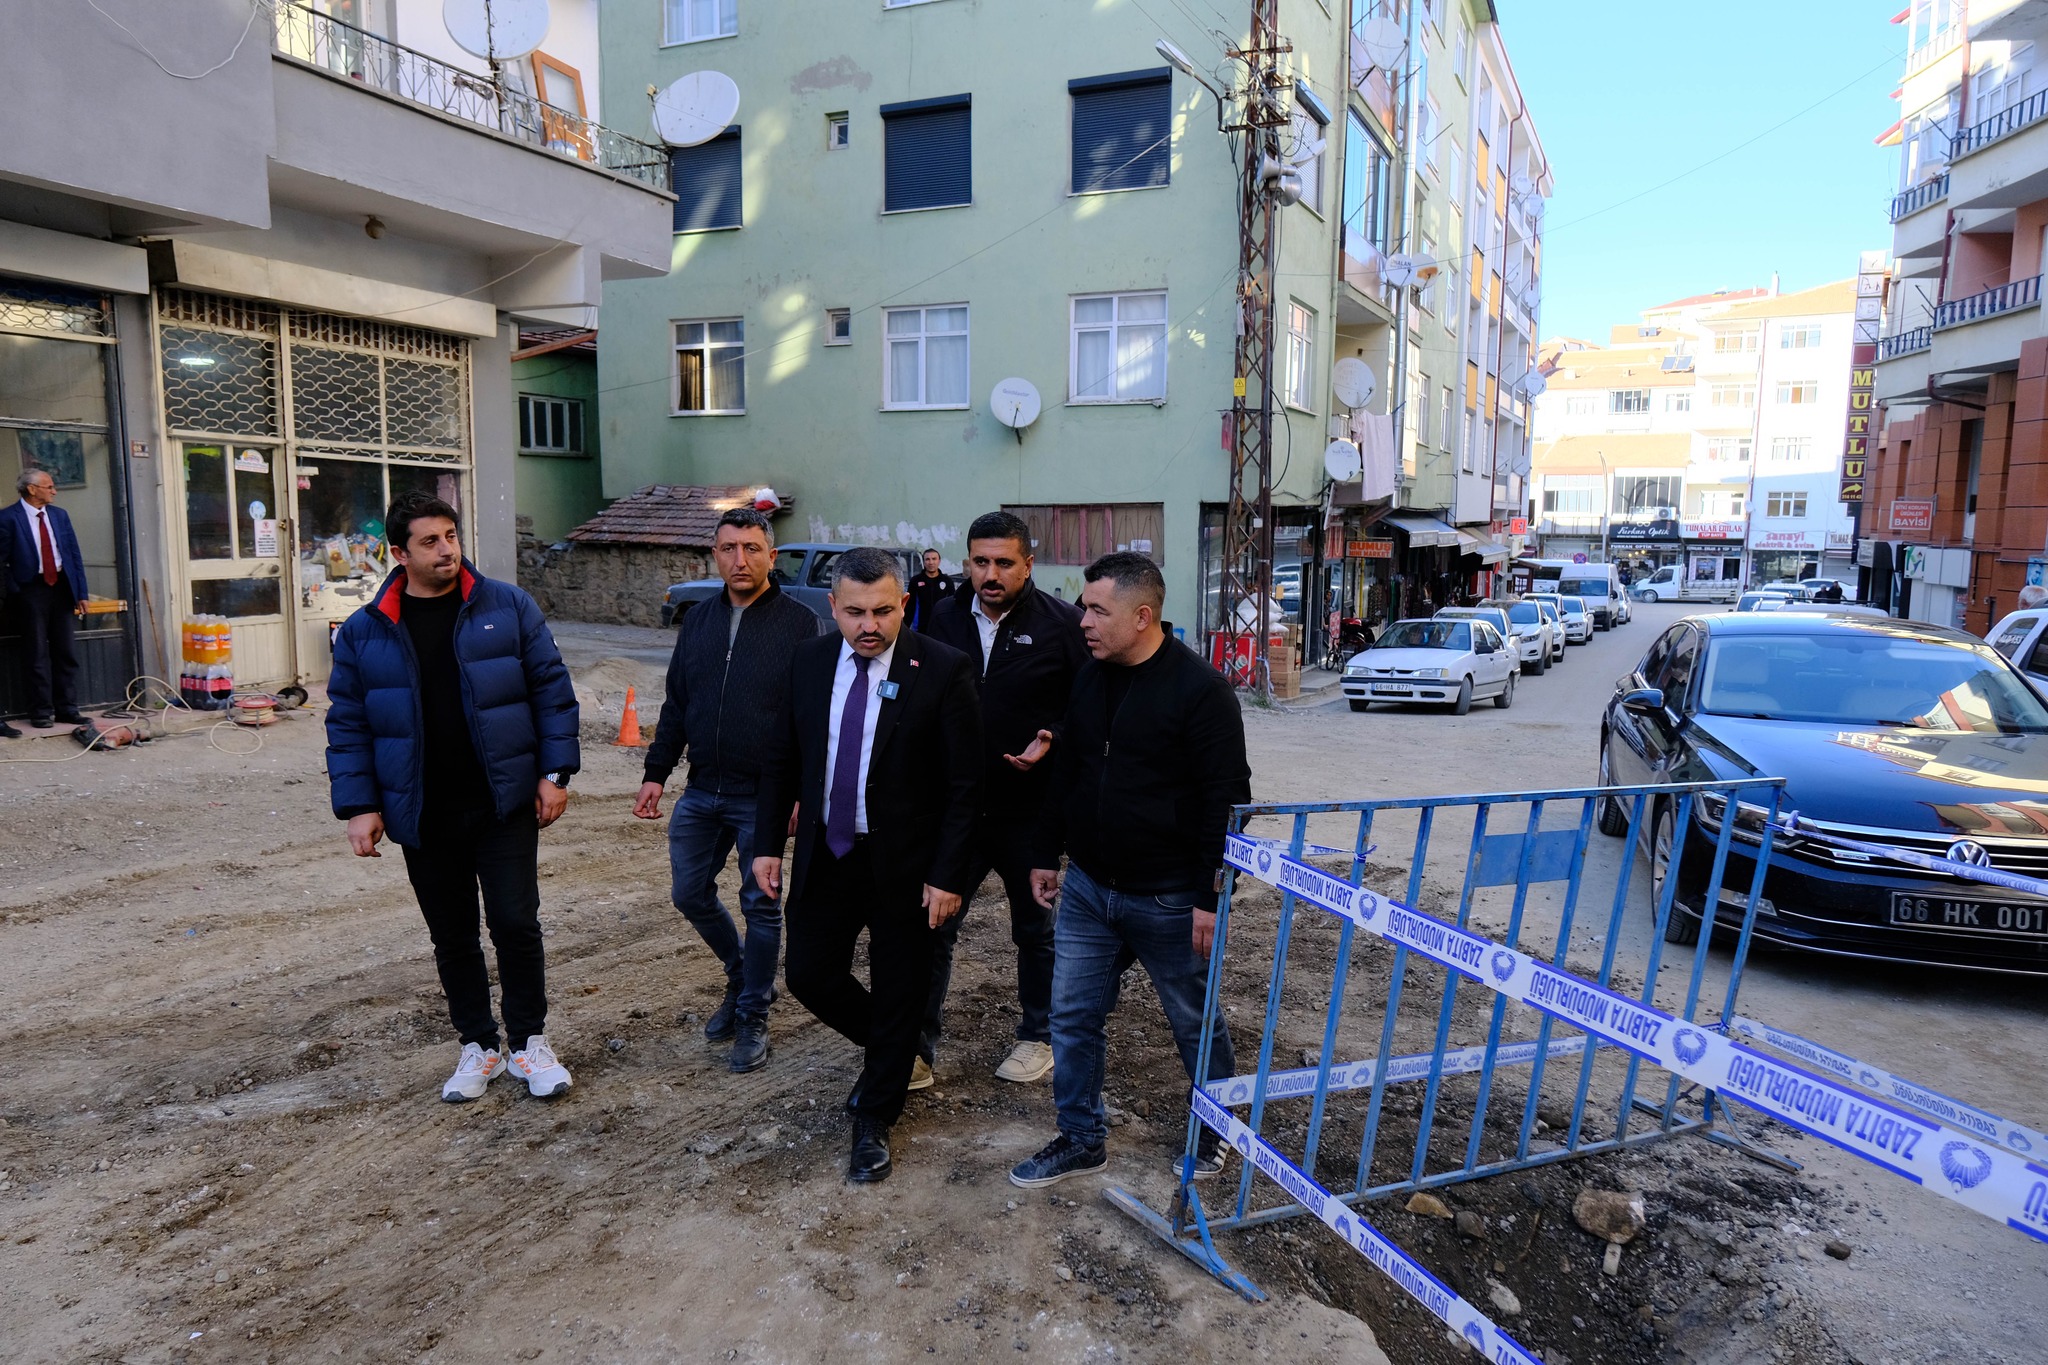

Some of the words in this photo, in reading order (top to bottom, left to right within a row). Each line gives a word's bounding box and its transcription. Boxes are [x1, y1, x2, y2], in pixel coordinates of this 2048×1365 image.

[1845, 370, 1872, 477] MUTLU
[1617, 526, 1646, 535] Furkan
[1766, 531, 1805, 542] sanayi
[1894, 517, 1927, 526] BAYİSİ
[1546, 551, 1575, 559] eczan
[1231, 839, 1253, 865] ZABITA
[1325, 880, 1353, 910] ZABITA
[1899, 898, 1928, 921] 66
[1944, 902, 1980, 925] HK
[1997, 906, 2043, 931] 001
[1446, 934, 1484, 969] ZABITA
[1609, 1003, 1663, 1047] ZABITA
[1845, 1101, 1923, 1161] ZABITA
[1255, 1146, 1279, 1179] ZABITA
[1358, 1232, 1390, 1276] ZABITA
